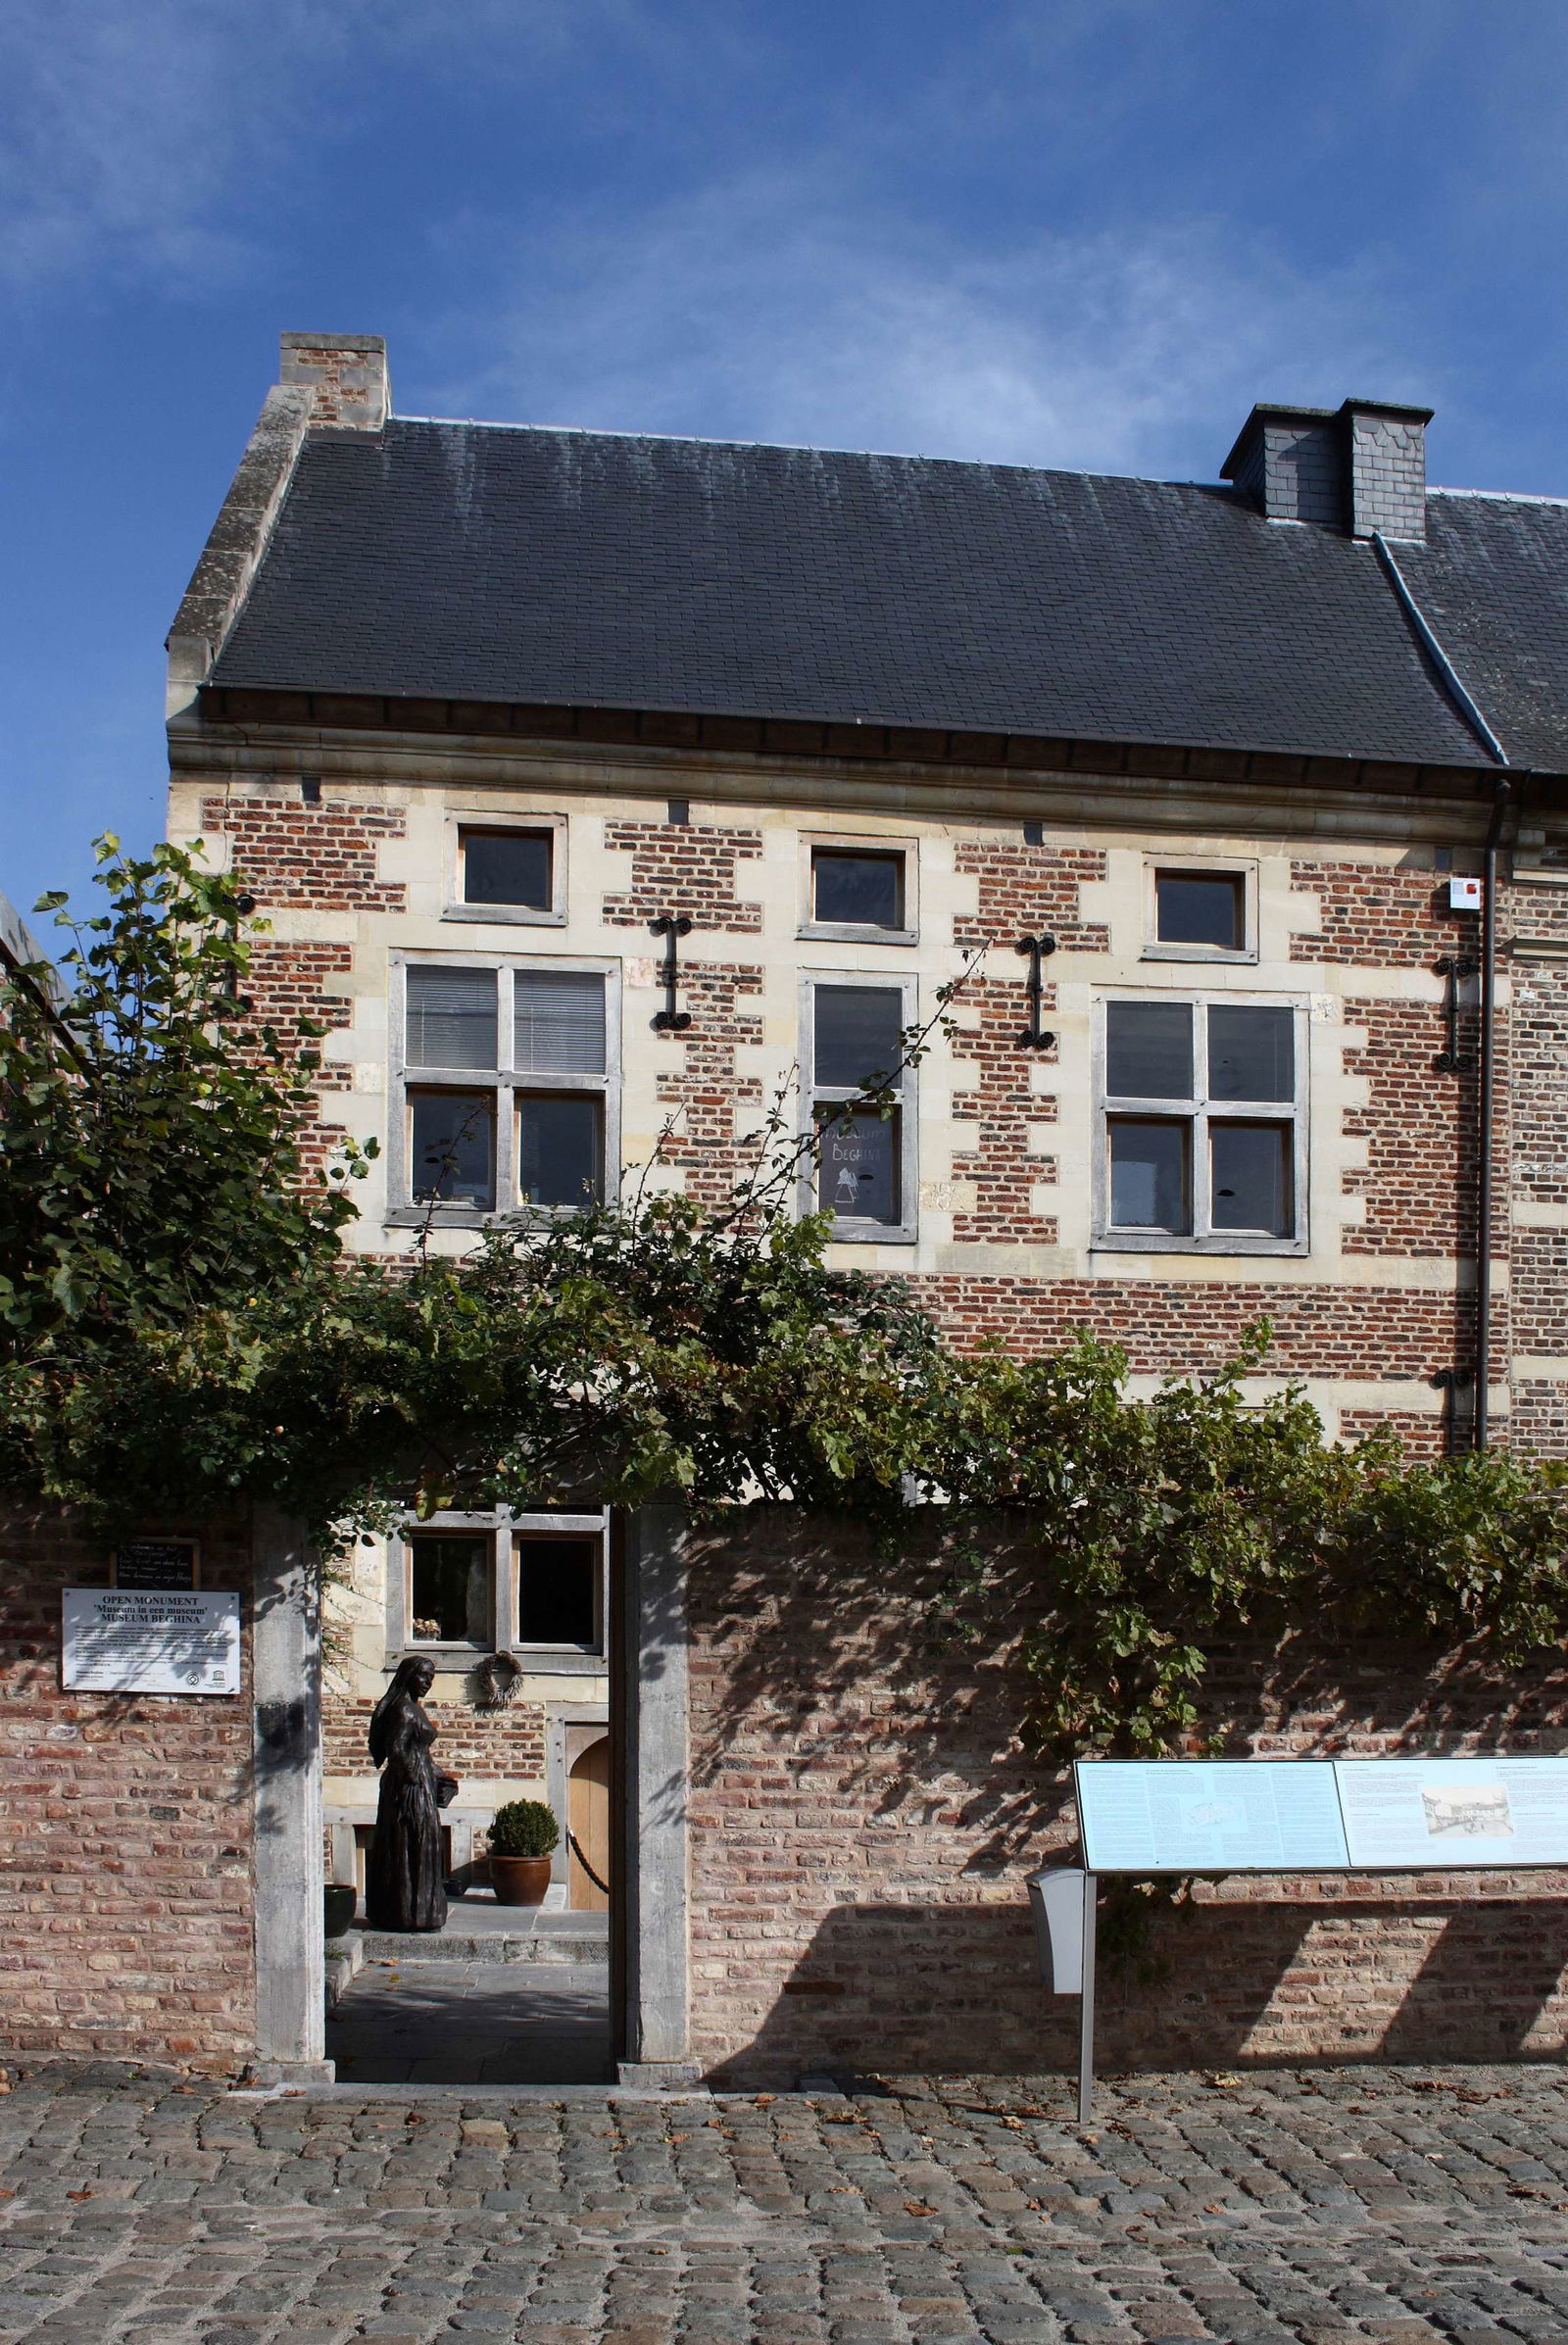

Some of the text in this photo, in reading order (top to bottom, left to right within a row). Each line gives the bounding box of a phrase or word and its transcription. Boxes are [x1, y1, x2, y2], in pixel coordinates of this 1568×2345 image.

[102, 1595, 199, 1606] OPEN MONUMENT
[101, 1613, 201, 1624] MUSEUM BEGHINA
